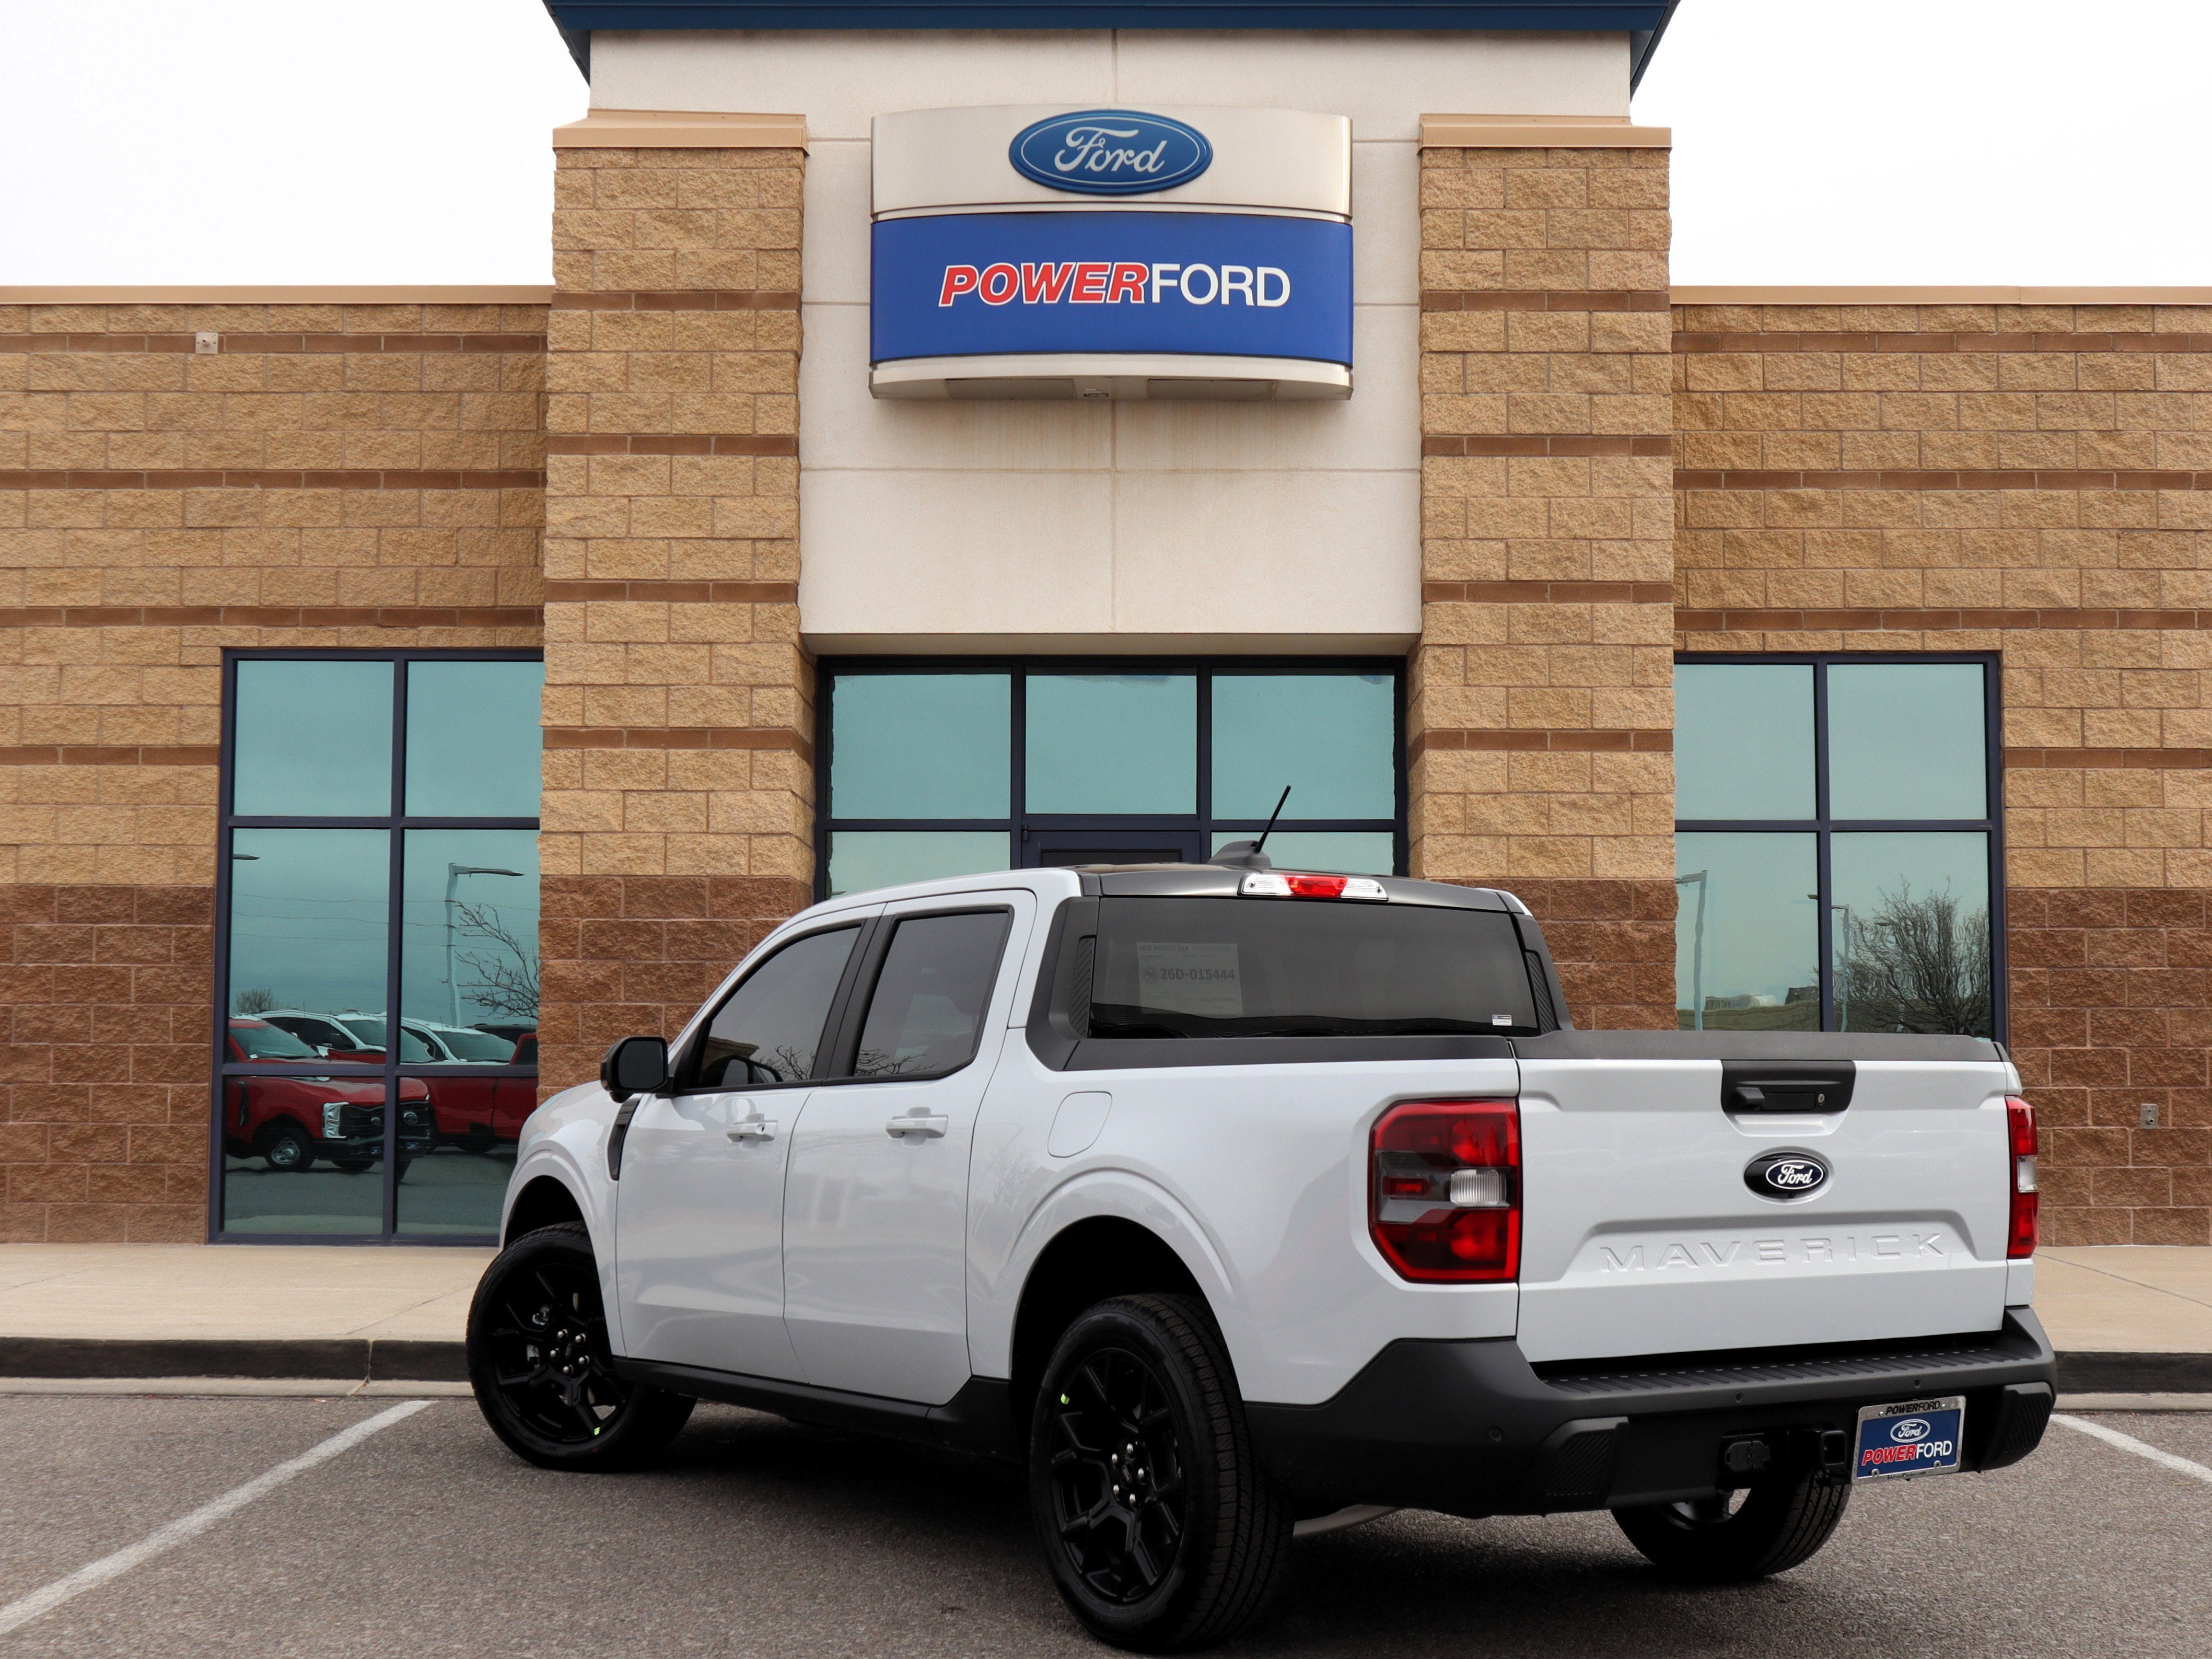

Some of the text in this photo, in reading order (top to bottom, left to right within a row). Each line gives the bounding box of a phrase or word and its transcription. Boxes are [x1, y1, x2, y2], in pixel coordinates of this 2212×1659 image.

[1054, 126, 1168, 173] Ford
[938, 262, 1291, 307] POWERFORD
[1160, 968, 1236, 981] 26D-015444
[1777, 1164, 1813, 1185] Ford
[1600, 1233, 1946, 1273] MAVERICK
[1885, 1400, 1941, 1416] POWERFORD
[1897, 1423, 1923, 1438] Ford
[1861, 1440, 1953, 1466] POWERFORD
